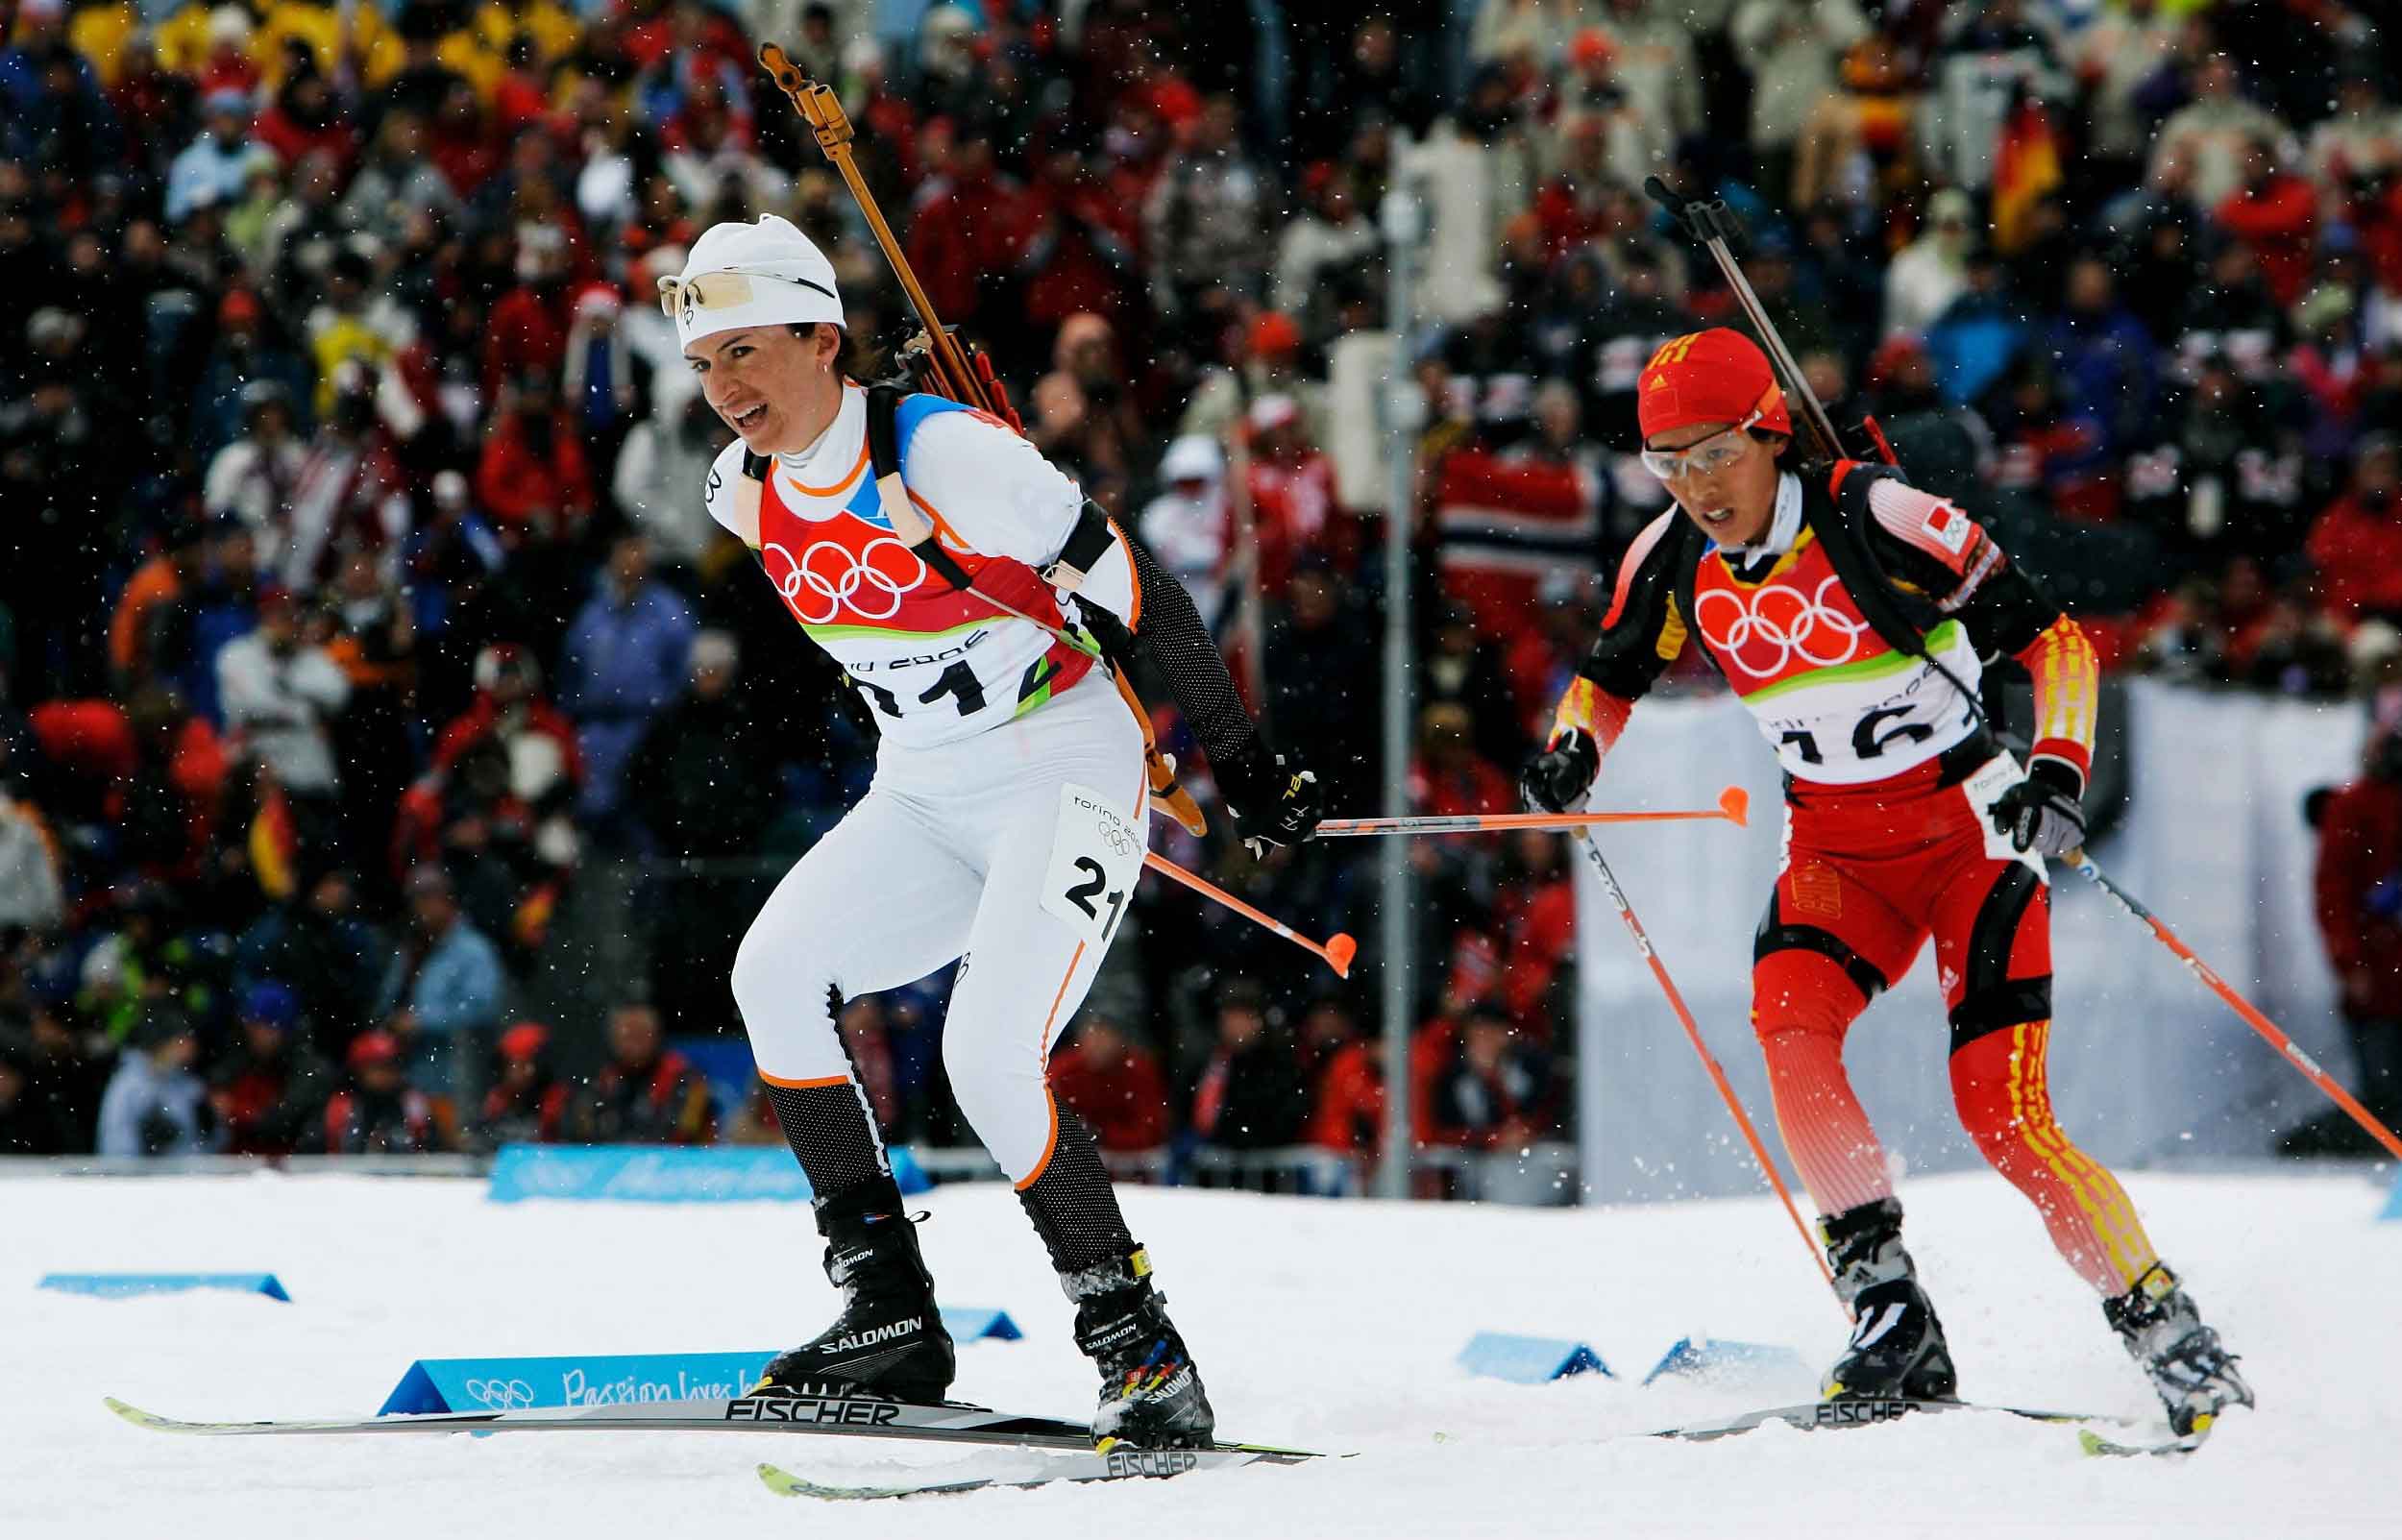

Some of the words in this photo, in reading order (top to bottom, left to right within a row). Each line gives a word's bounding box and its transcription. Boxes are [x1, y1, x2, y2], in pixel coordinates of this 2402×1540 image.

[1065, 855, 1125, 943] 21
[819, 1315, 922, 1355] SALOMON
[1085, 1323, 1137, 1350] SALOMON
[562, 1368, 673, 1406] Passion
[724, 1399, 900, 1426] FISCHER
[1107, 1452, 1197, 1477] FISCHER
